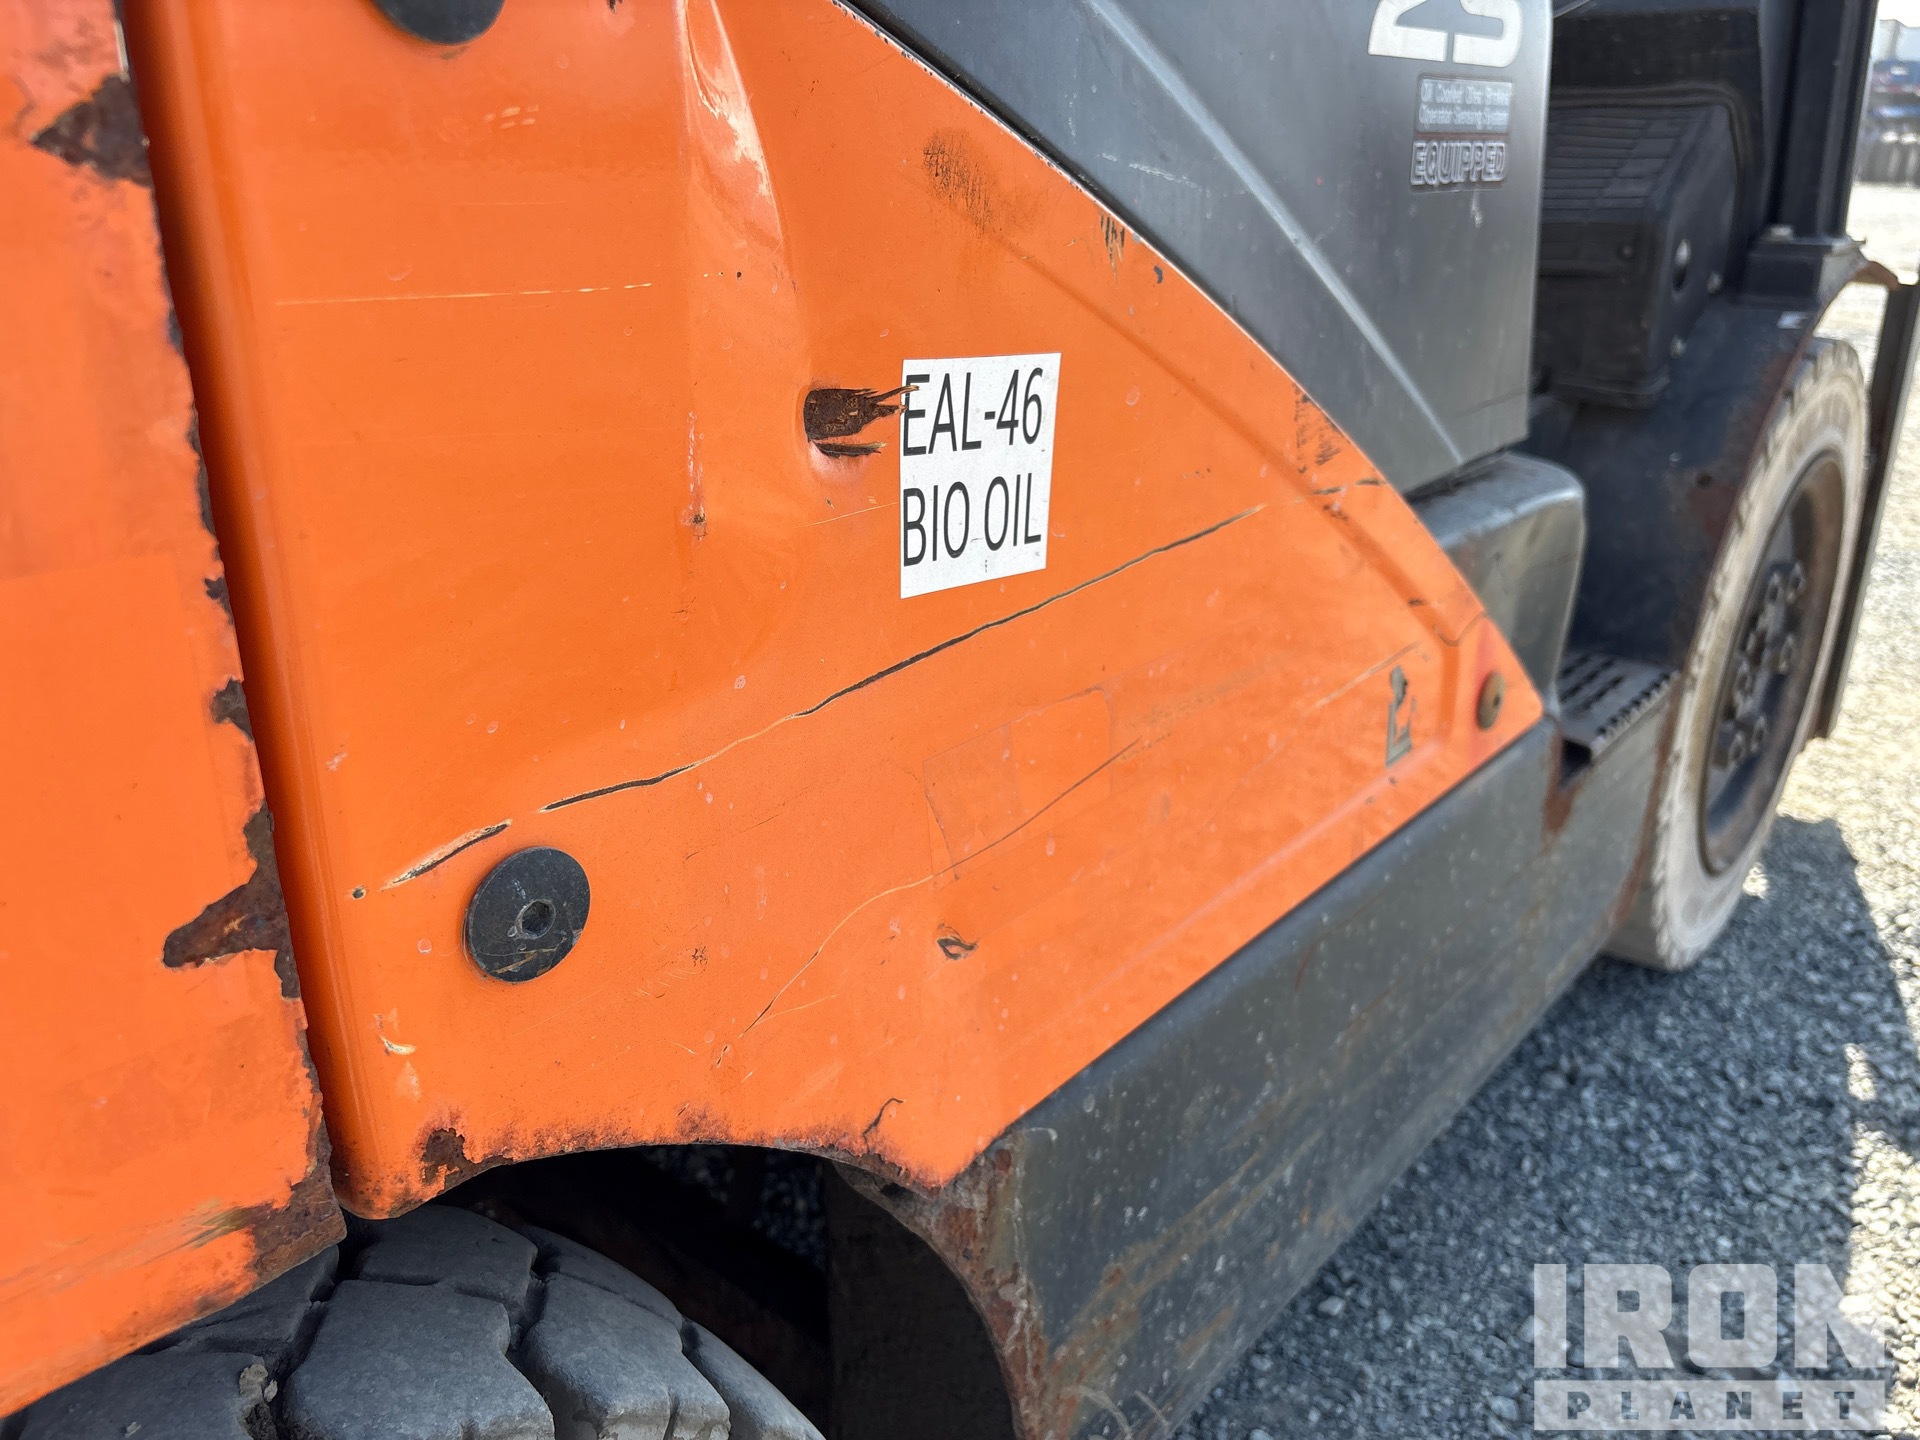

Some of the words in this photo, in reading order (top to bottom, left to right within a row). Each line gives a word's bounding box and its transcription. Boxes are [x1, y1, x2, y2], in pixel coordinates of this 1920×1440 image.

[1410, 141, 1506, 186] EQUIPPED
[903, 367, 1043, 456] EAL-46
[903, 481, 970, 567] BIO
[984, 473, 1041, 551] OIL
